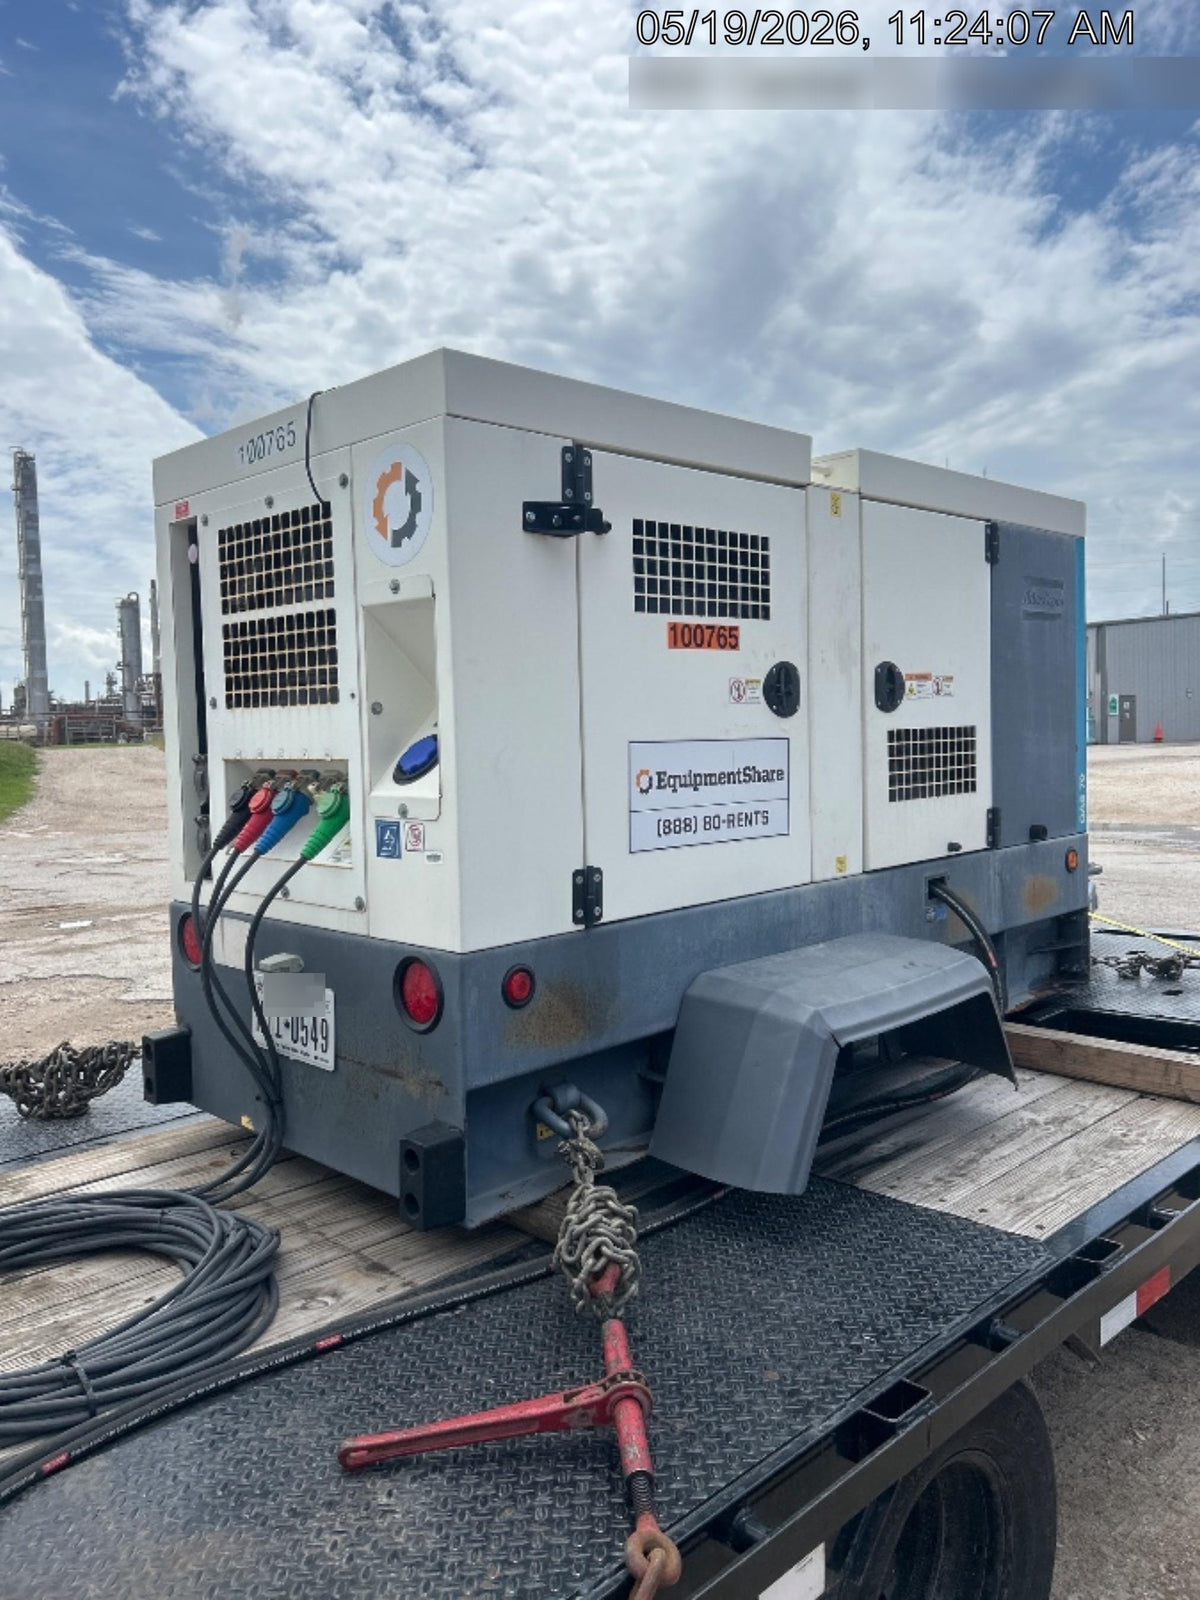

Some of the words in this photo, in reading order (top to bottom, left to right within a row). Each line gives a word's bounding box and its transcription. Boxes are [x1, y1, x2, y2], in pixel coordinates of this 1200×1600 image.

[239, 421, 296, 464] 100765
[669, 622, 739, 650] 100765
[655, 765, 785, 793] EquipmentShare
[657, 815, 698, 838] (888)
